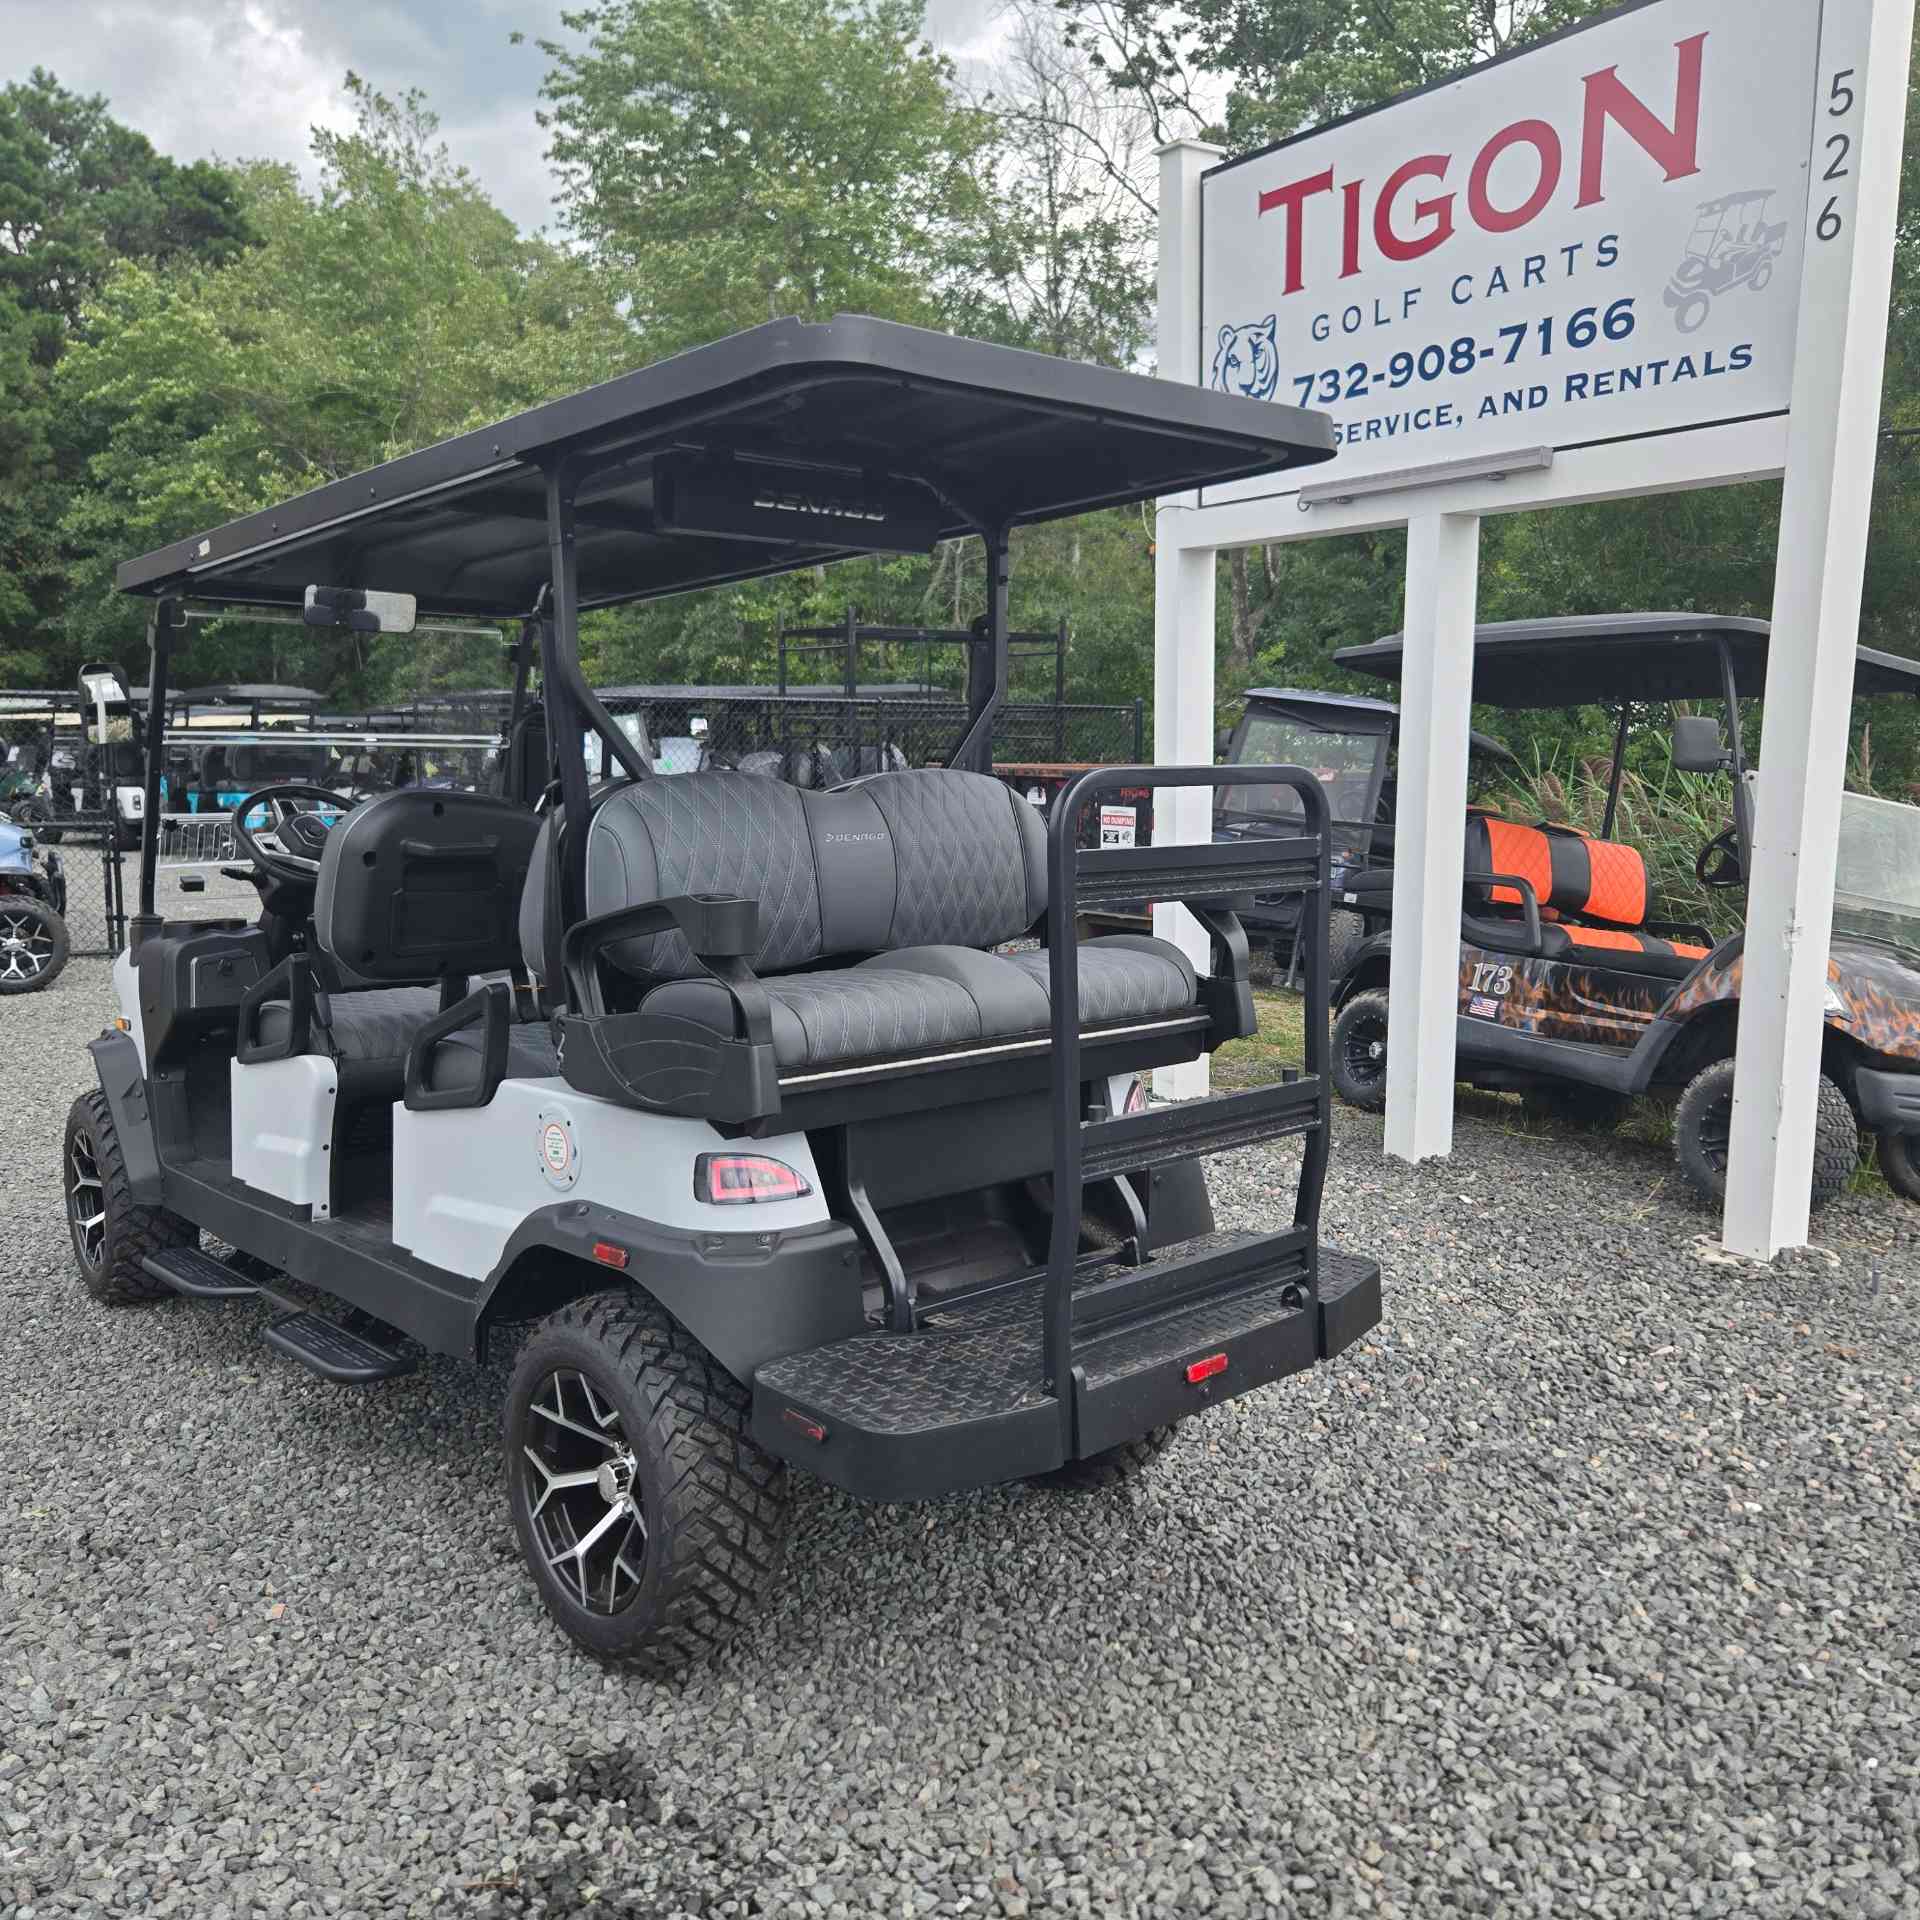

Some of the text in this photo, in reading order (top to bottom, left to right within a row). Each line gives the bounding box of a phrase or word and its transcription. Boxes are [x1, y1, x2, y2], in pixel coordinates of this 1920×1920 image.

[1259, 31, 1709, 296] TIGON
[1312, 234, 1619, 342] GOLF CARTS
[1293, 298, 1635, 408] 732-908-7166
[1478, 385, 1548, 419] AND
[1564, 344, 1753, 402] RENTALS
[1468, 962, 1513, 995] 173
